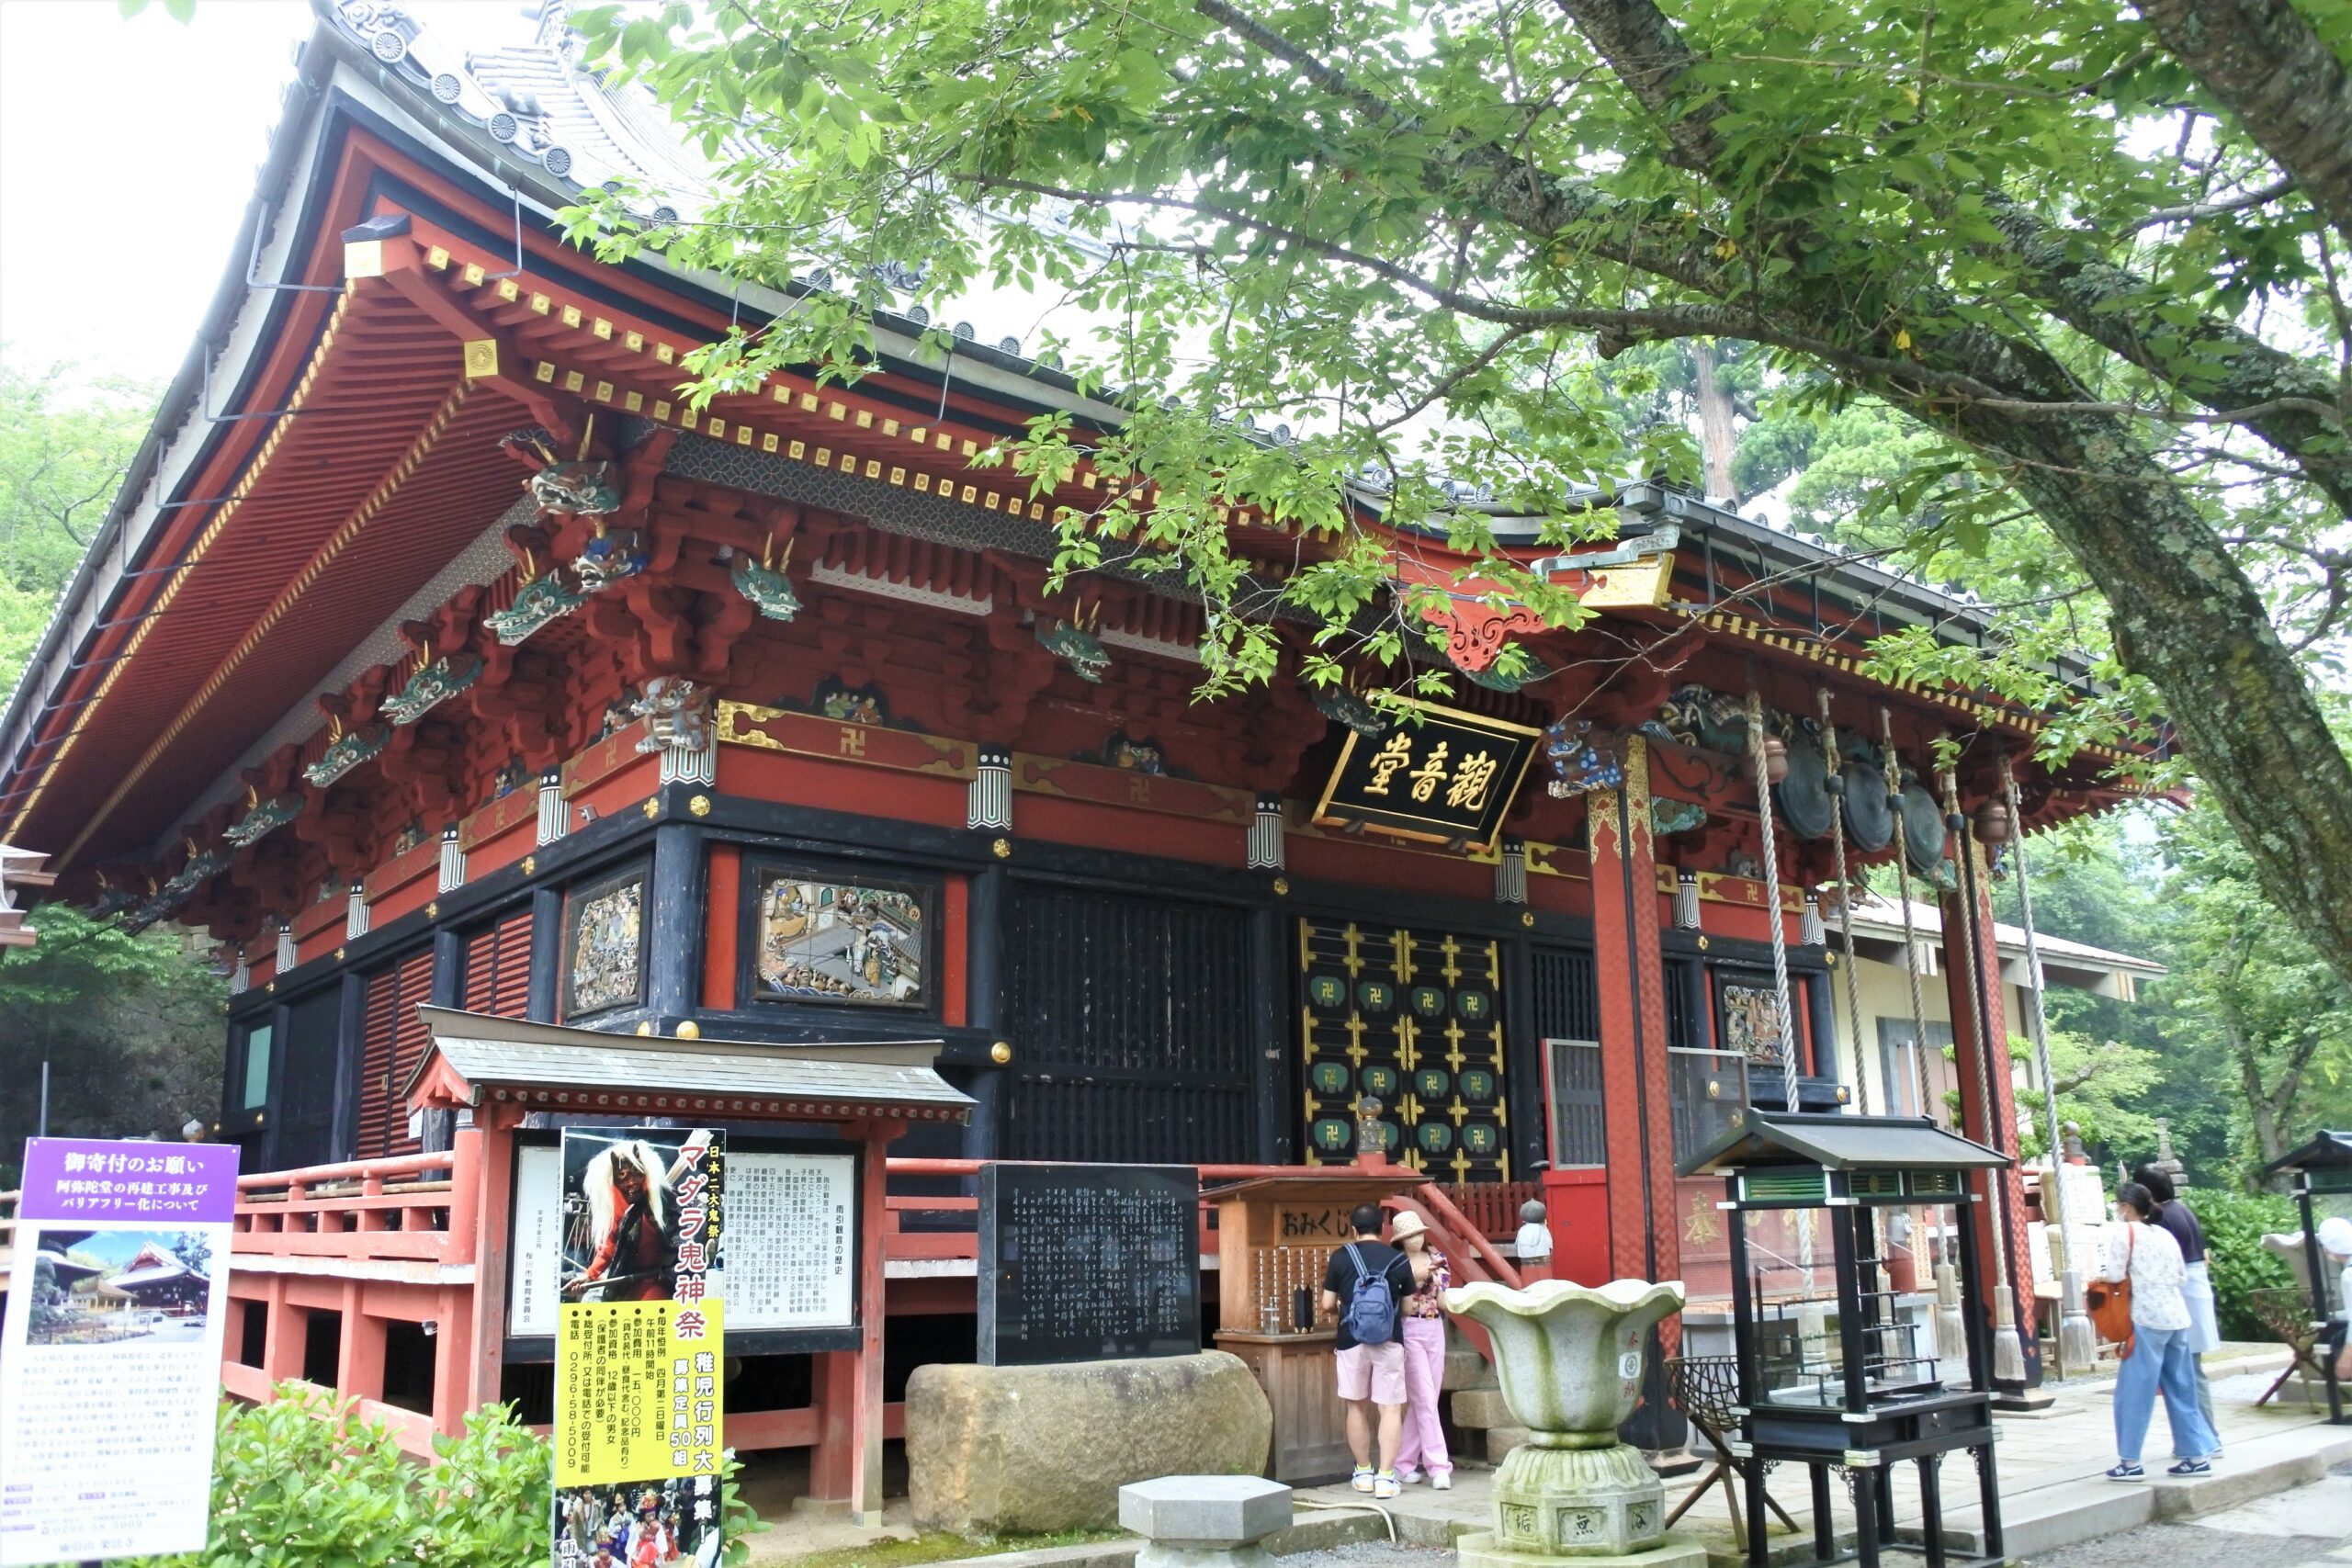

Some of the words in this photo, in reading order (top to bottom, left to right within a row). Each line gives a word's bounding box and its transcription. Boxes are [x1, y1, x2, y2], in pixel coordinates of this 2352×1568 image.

[56, 1179, 208, 1196] 阿弥陀堂の再建工事及び
[64, 1152, 204, 1175] 御寄付のお願い
[62, 1197, 199, 1211] バリアフリー化について
[707, 1145, 720, 1238] 日本二大鬼祭
[674, 1145, 707, 1339] マダラ鬼神祭
[834, 1205, 844, 1275] 雨引観音の歴史
[1283, 1210, 1350, 1237] おみくじ
[570, 1320, 579, 1339] 電話
[608, 1319, 617, 1359] 参加資格
[633, 1319, 642, 1359] 参加費用
[645, 1319, 655, 1380] 午前11時開始
[657, 1316, 666, 1357] 毎年恒例
[568, 1352, 578, 1468] 0296-58-5009
[606, 1371, 617, 1444] 12歳以下の男女
[656, 1369, 665, 1441] 四月第二日曜日
[670, 1359, 692, 1467] 募集定員50組
